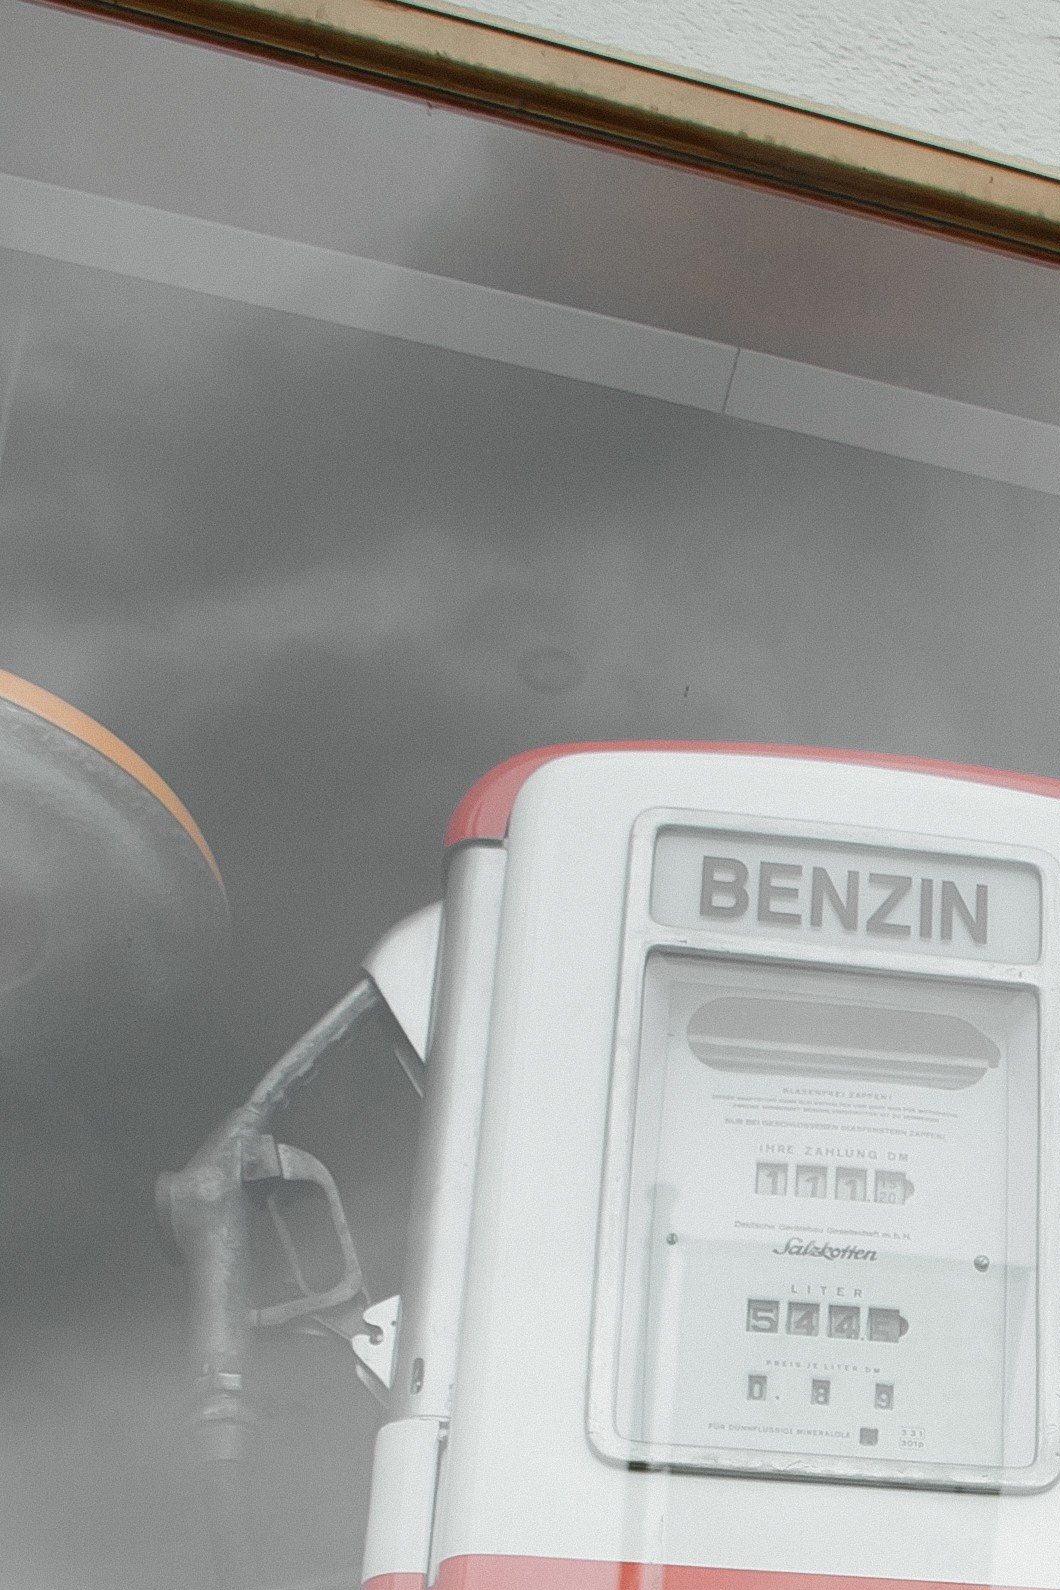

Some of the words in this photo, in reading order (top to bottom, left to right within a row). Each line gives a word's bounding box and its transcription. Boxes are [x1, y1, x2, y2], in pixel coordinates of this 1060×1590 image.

[699, 855, 989, 945] BENZIN
[759, 1143, 795, 1155] IHRE
[804, 1146, 878, 1161] ZAHLUNG
[887, 1151, 909, 1163] DM
[771, 1236, 878, 1262] Salzkotten
[790, 1284, 863, 1298] LITER
[765, 1359, 801, 1369] PREIS
[824, 1363, 858, 1372] LITER
[864, 1365, 881, 1374] DM
